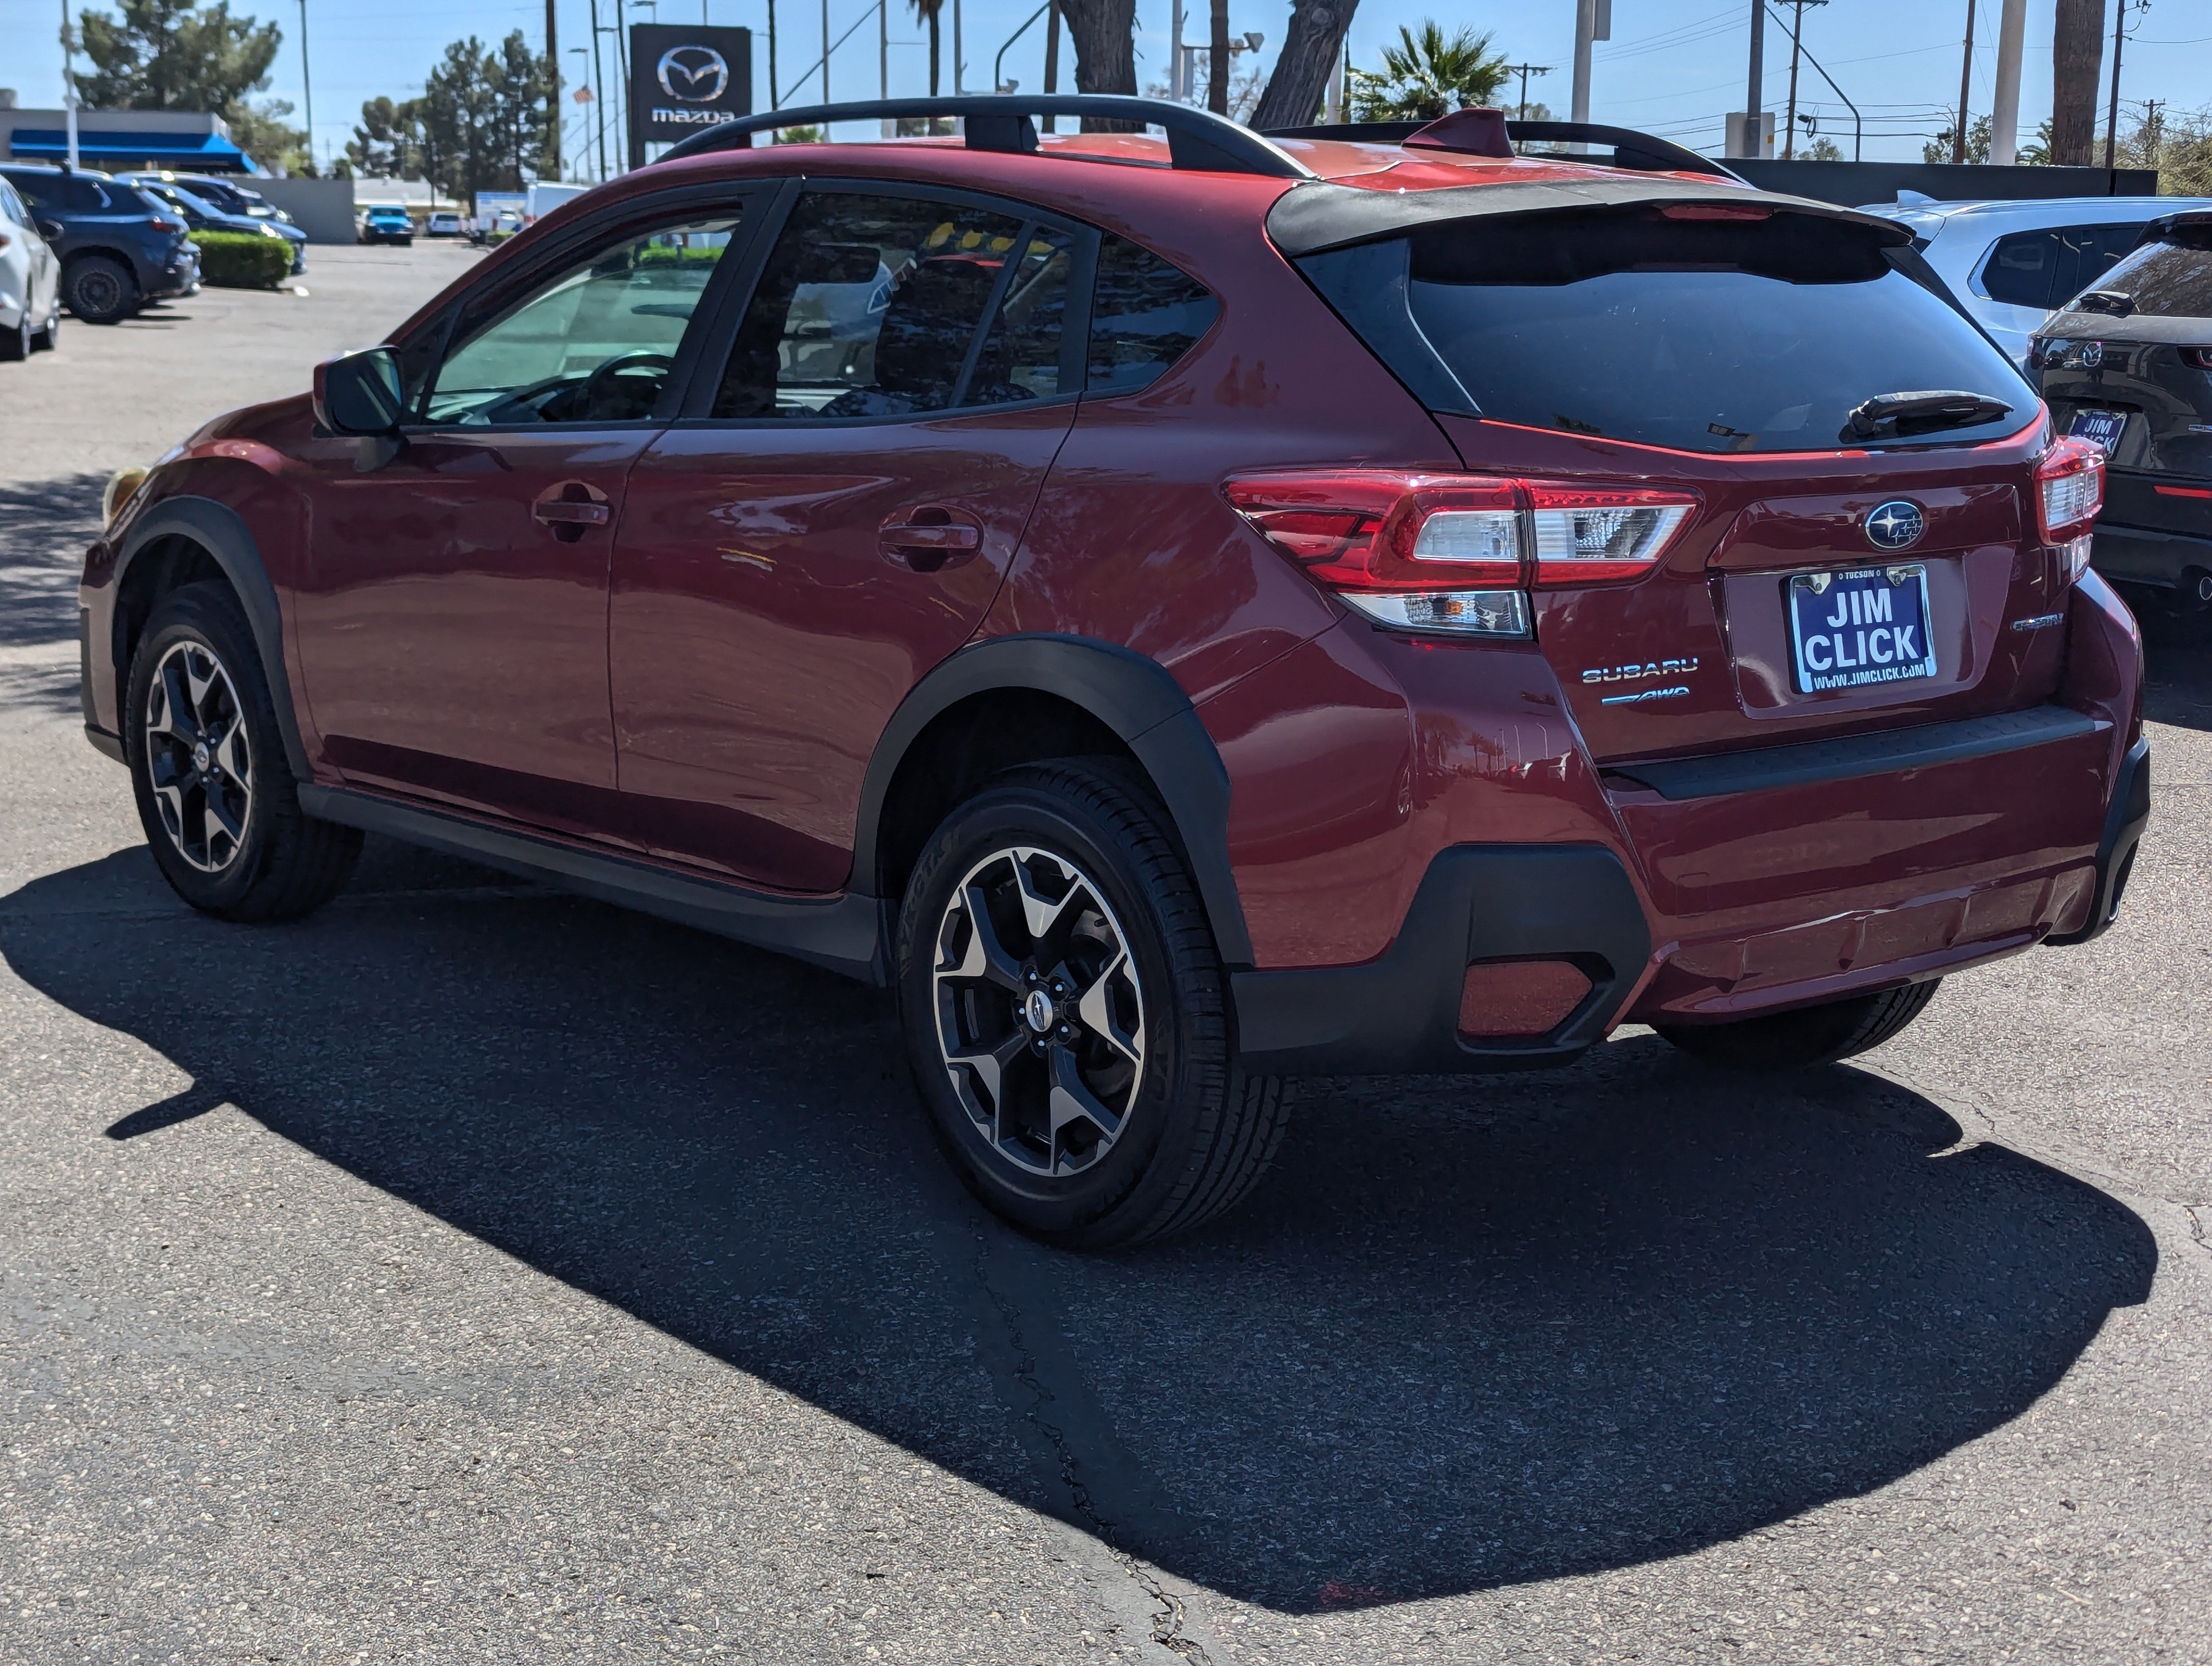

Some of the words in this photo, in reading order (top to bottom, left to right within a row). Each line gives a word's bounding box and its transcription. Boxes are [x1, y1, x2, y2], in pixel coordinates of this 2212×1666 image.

[652, 108, 735, 124] mazda
[2084, 419, 2113, 434] JIM
[1844, 570, 1875, 580] TUCSON
[1827, 588, 1893, 627] JIM
[1805, 625, 1919, 671] CLICK
[1582, 657, 1699, 683] SUBARU
[1814, 663, 1925, 690] WWW.JIMCLICK.COM
[1636, 686, 1690, 702] AWD
